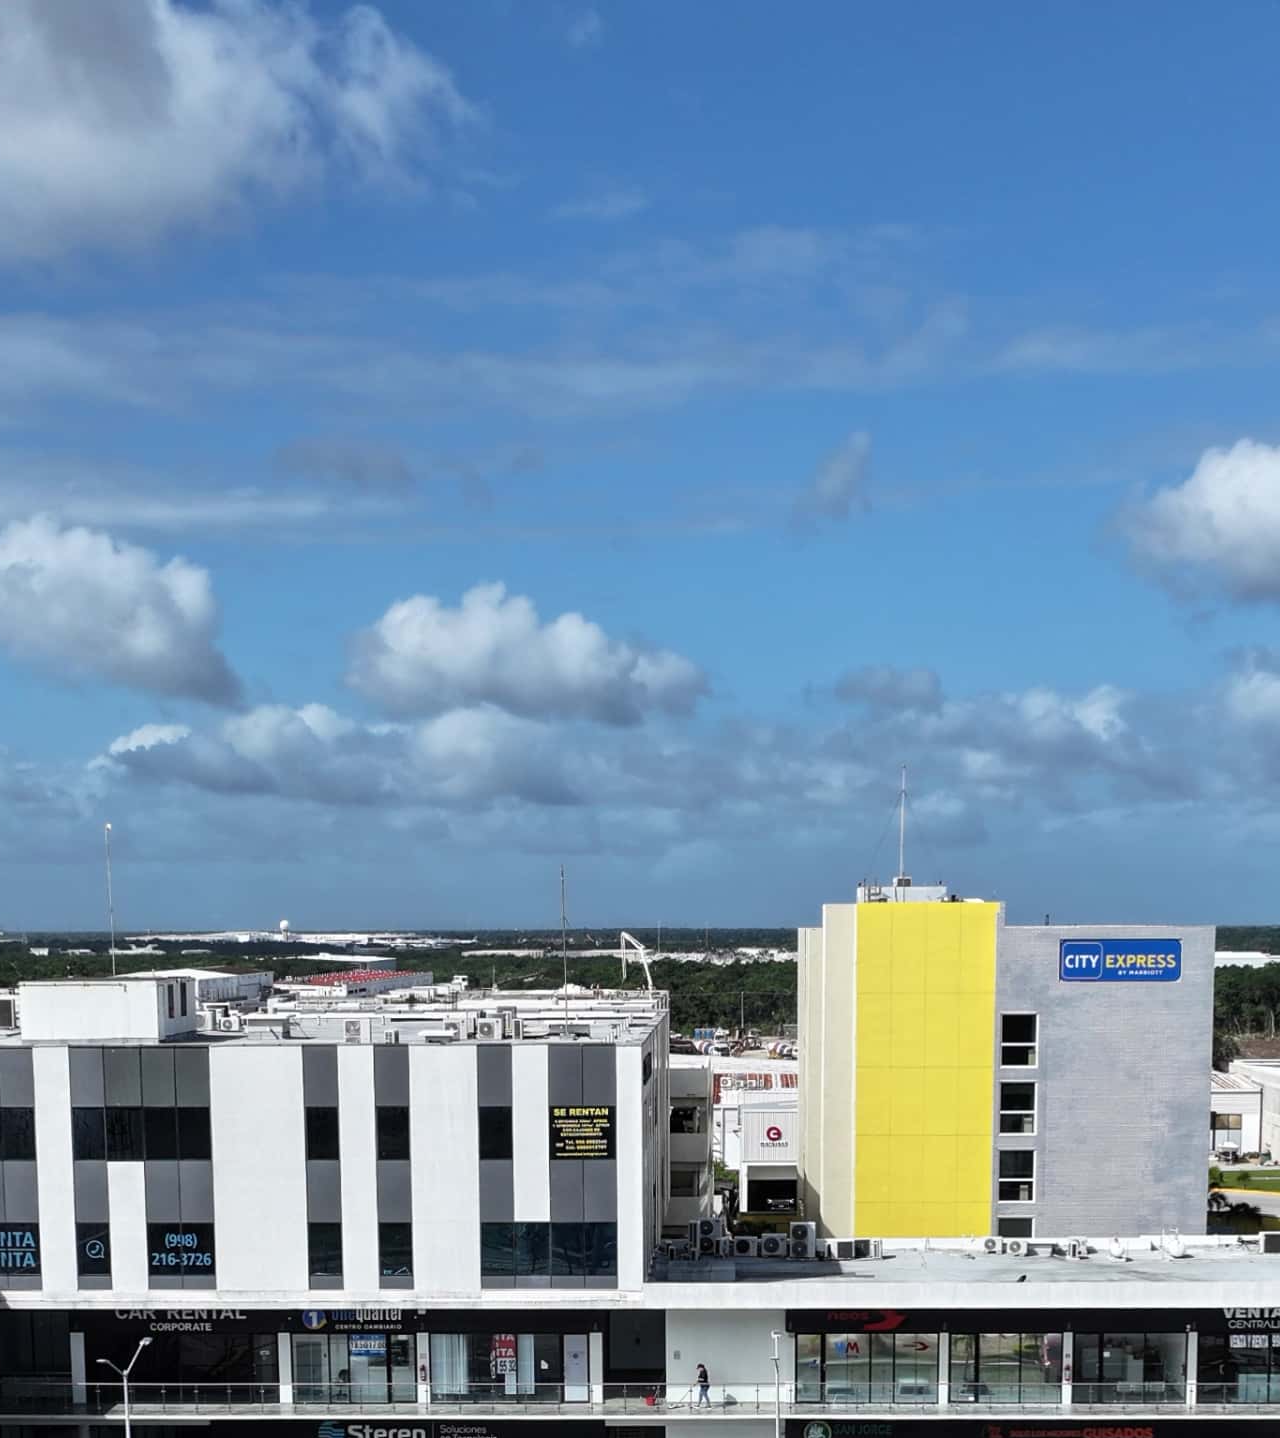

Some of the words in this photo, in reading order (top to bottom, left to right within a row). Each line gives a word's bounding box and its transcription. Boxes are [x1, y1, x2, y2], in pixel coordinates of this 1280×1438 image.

[1064, 954, 1100, 969] CITY
[1105, 954, 1177, 969] EXPRESS
[553, 1108, 567, 1116] SE
[569, 1108, 609, 1116] RENTAN
[164, 1233, 198, 1249] (998)
[151, 1252, 213, 1267] 216-3726
[115, 1309, 155, 1320] CAR
[168, 1309, 248, 1320] RENTAL
[149, 1323, 213, 1332] CORPORATE
[439, 1424, 488, 1435] Soluciones
